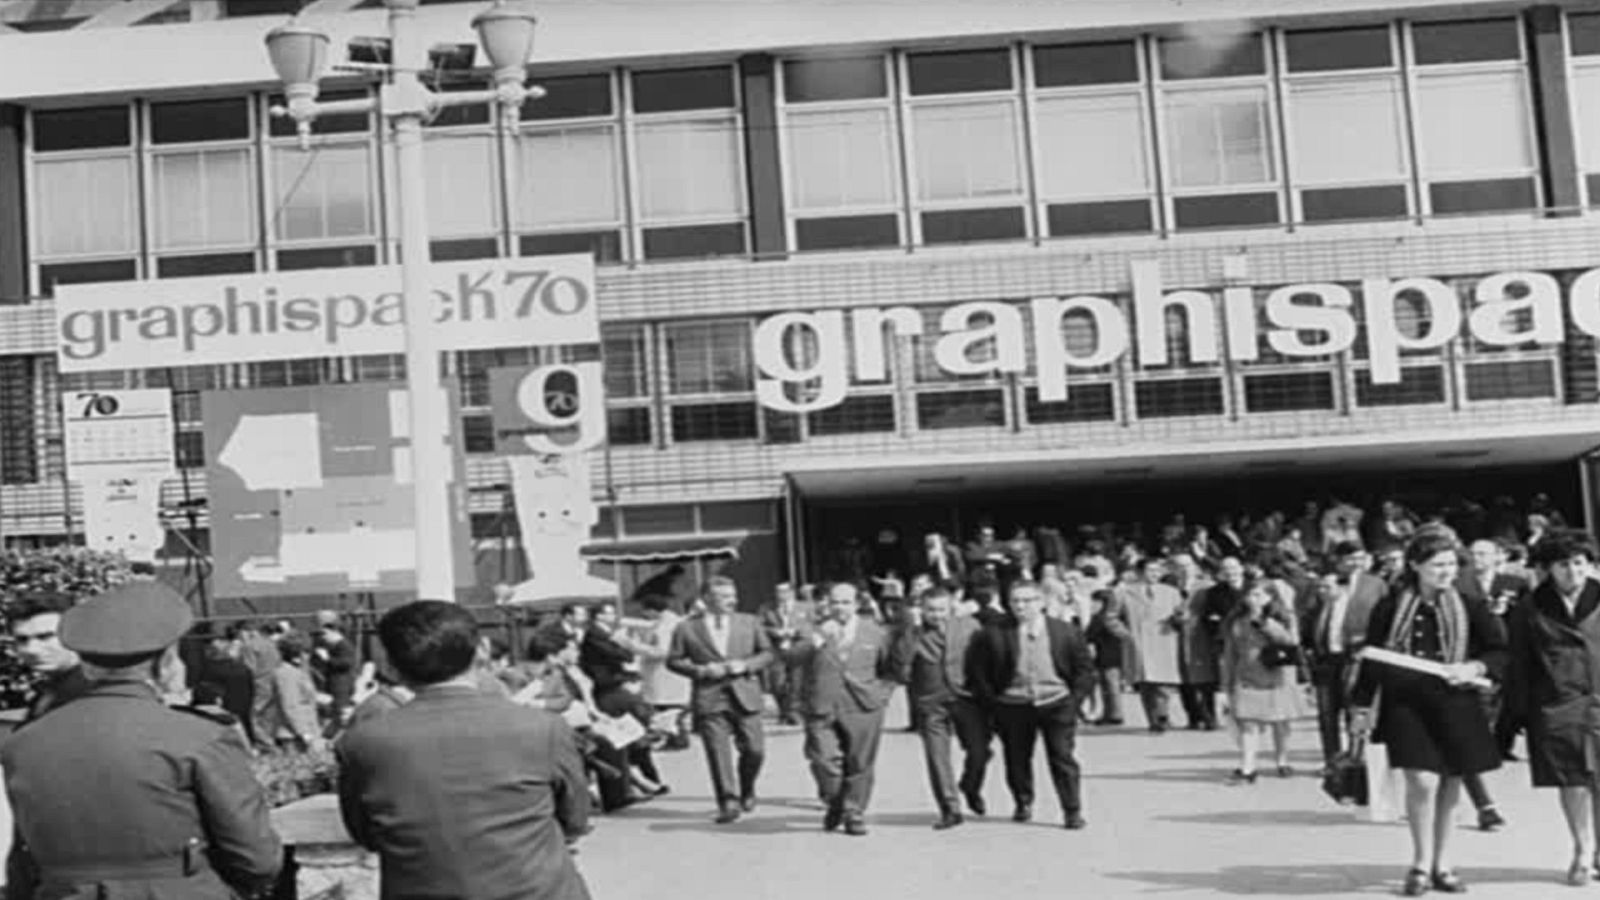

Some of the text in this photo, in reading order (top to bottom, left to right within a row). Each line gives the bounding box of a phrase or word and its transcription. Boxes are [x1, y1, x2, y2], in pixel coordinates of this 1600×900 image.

[504, 270, 589, 318] 70
[77, 393, 119, 418] 70
[518, 361, 606, 455] g
